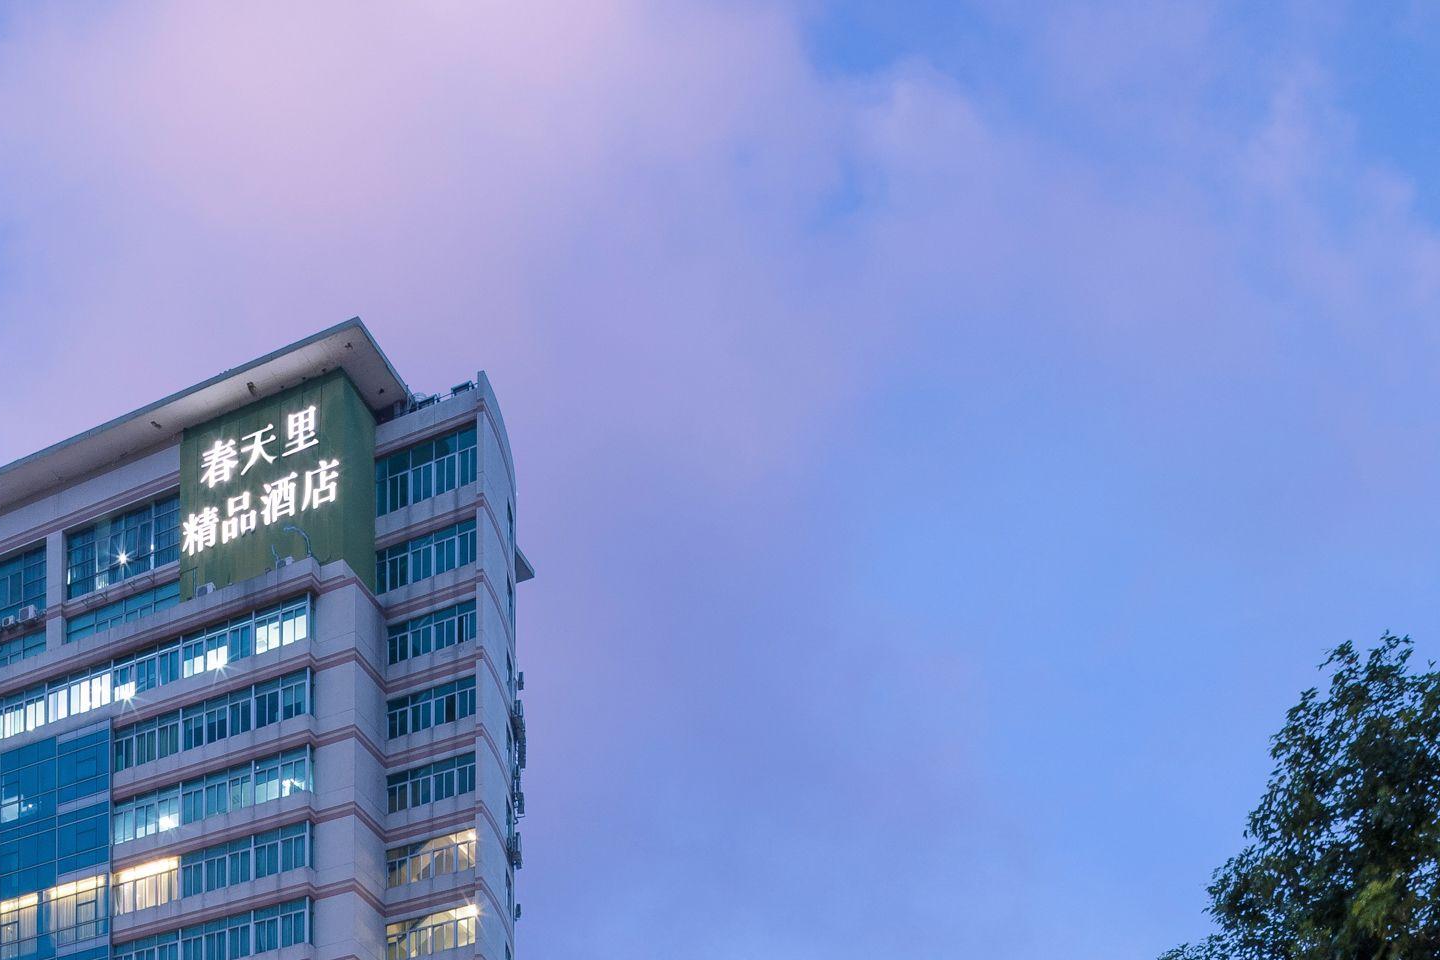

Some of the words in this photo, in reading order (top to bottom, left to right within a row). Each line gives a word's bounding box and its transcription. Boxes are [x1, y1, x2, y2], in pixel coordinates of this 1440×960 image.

[200, 405, 319, 488] 春天里
[182, 459, 340, 556] 精品酒店
